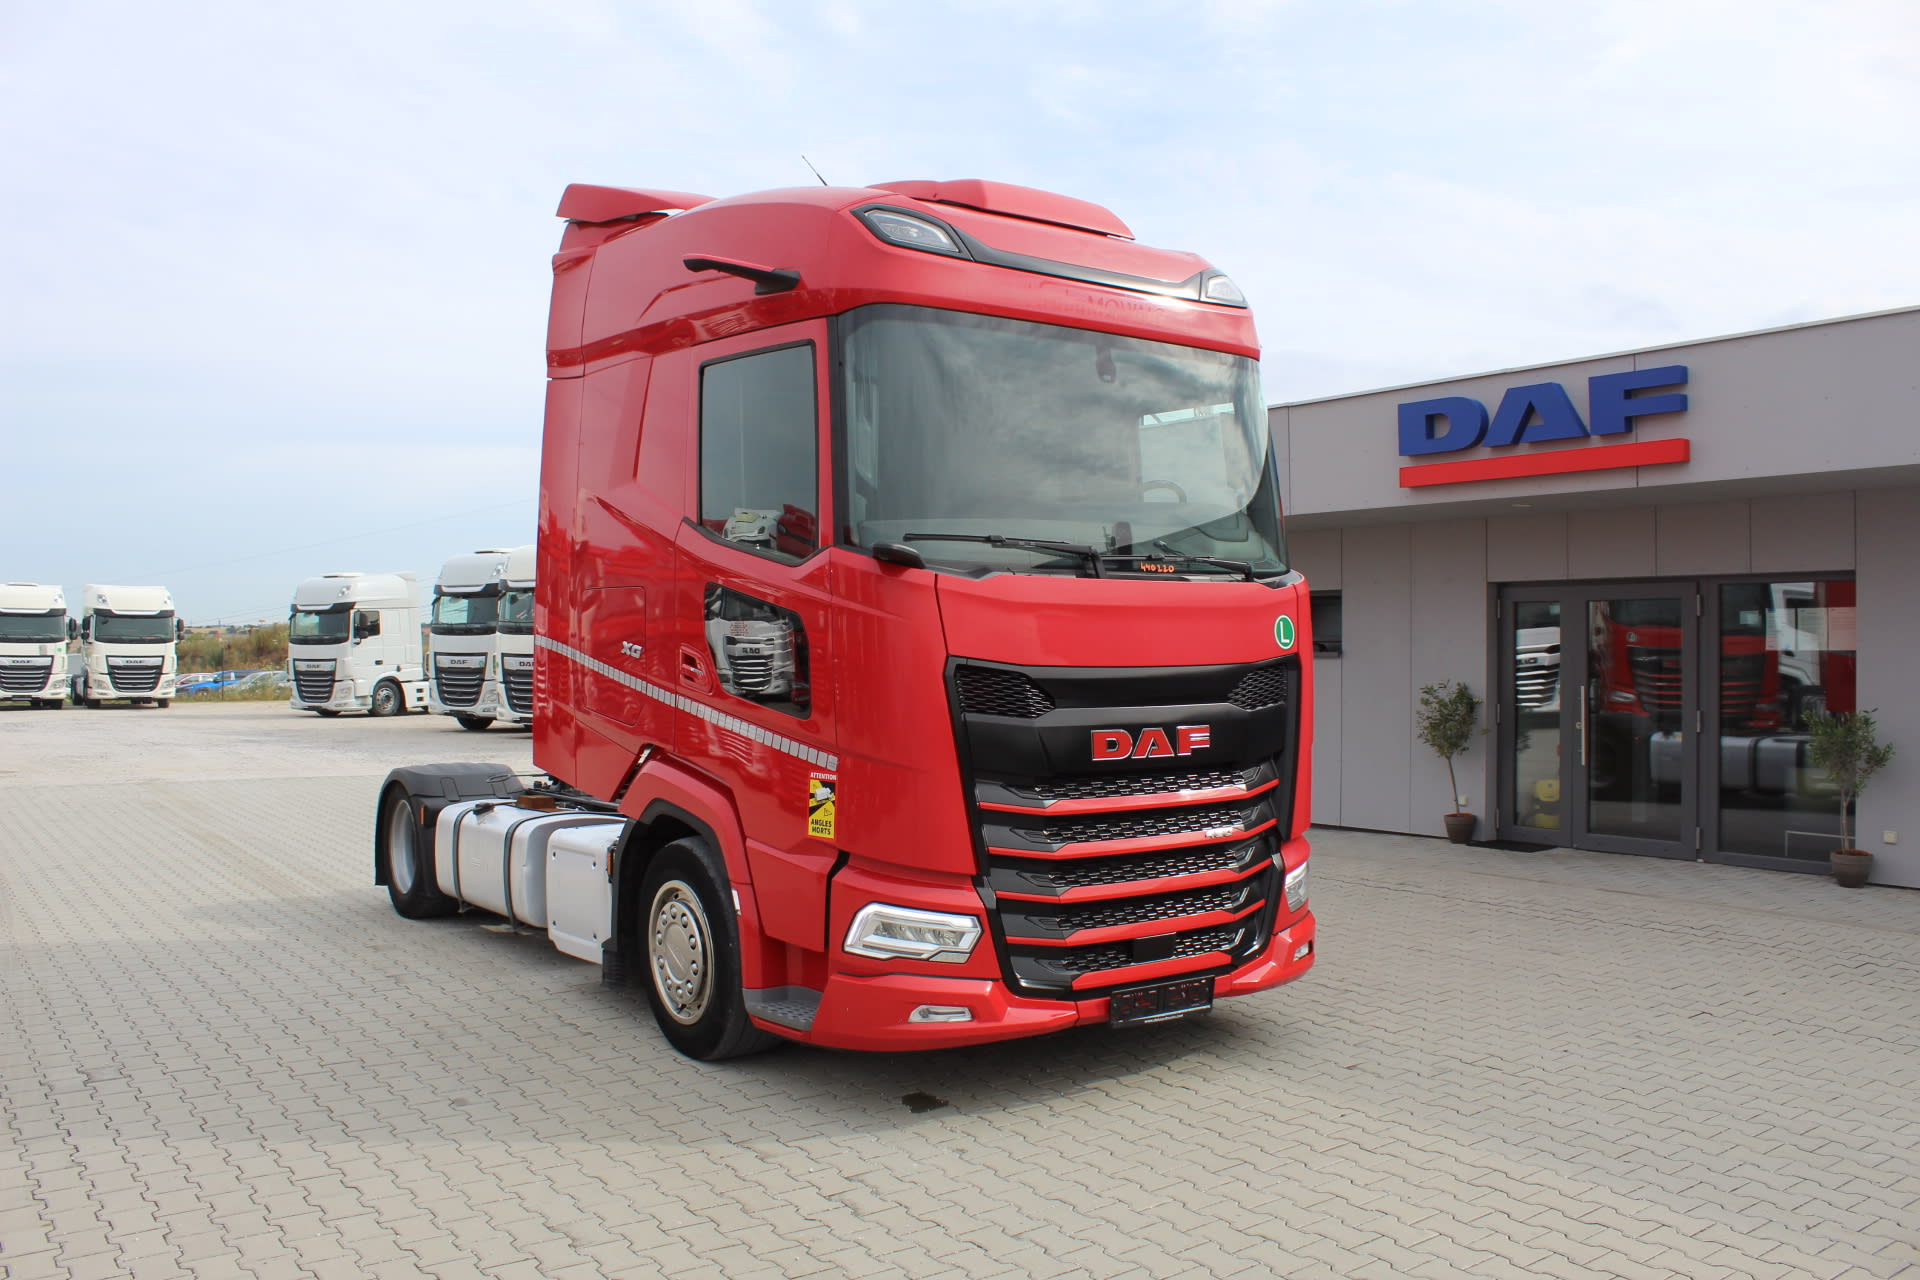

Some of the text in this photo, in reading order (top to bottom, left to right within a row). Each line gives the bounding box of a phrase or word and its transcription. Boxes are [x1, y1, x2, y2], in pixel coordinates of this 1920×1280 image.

[1398, 365, 1687, 456] DAF
[621, 640, 643, 659] XG
[1091, 725, 1210, 761] DAF
[810, 771, 837, 781] ATTENTION
[811, 818, 832, 828] ANGLES
[811, 826, 831, 835] MORTS
